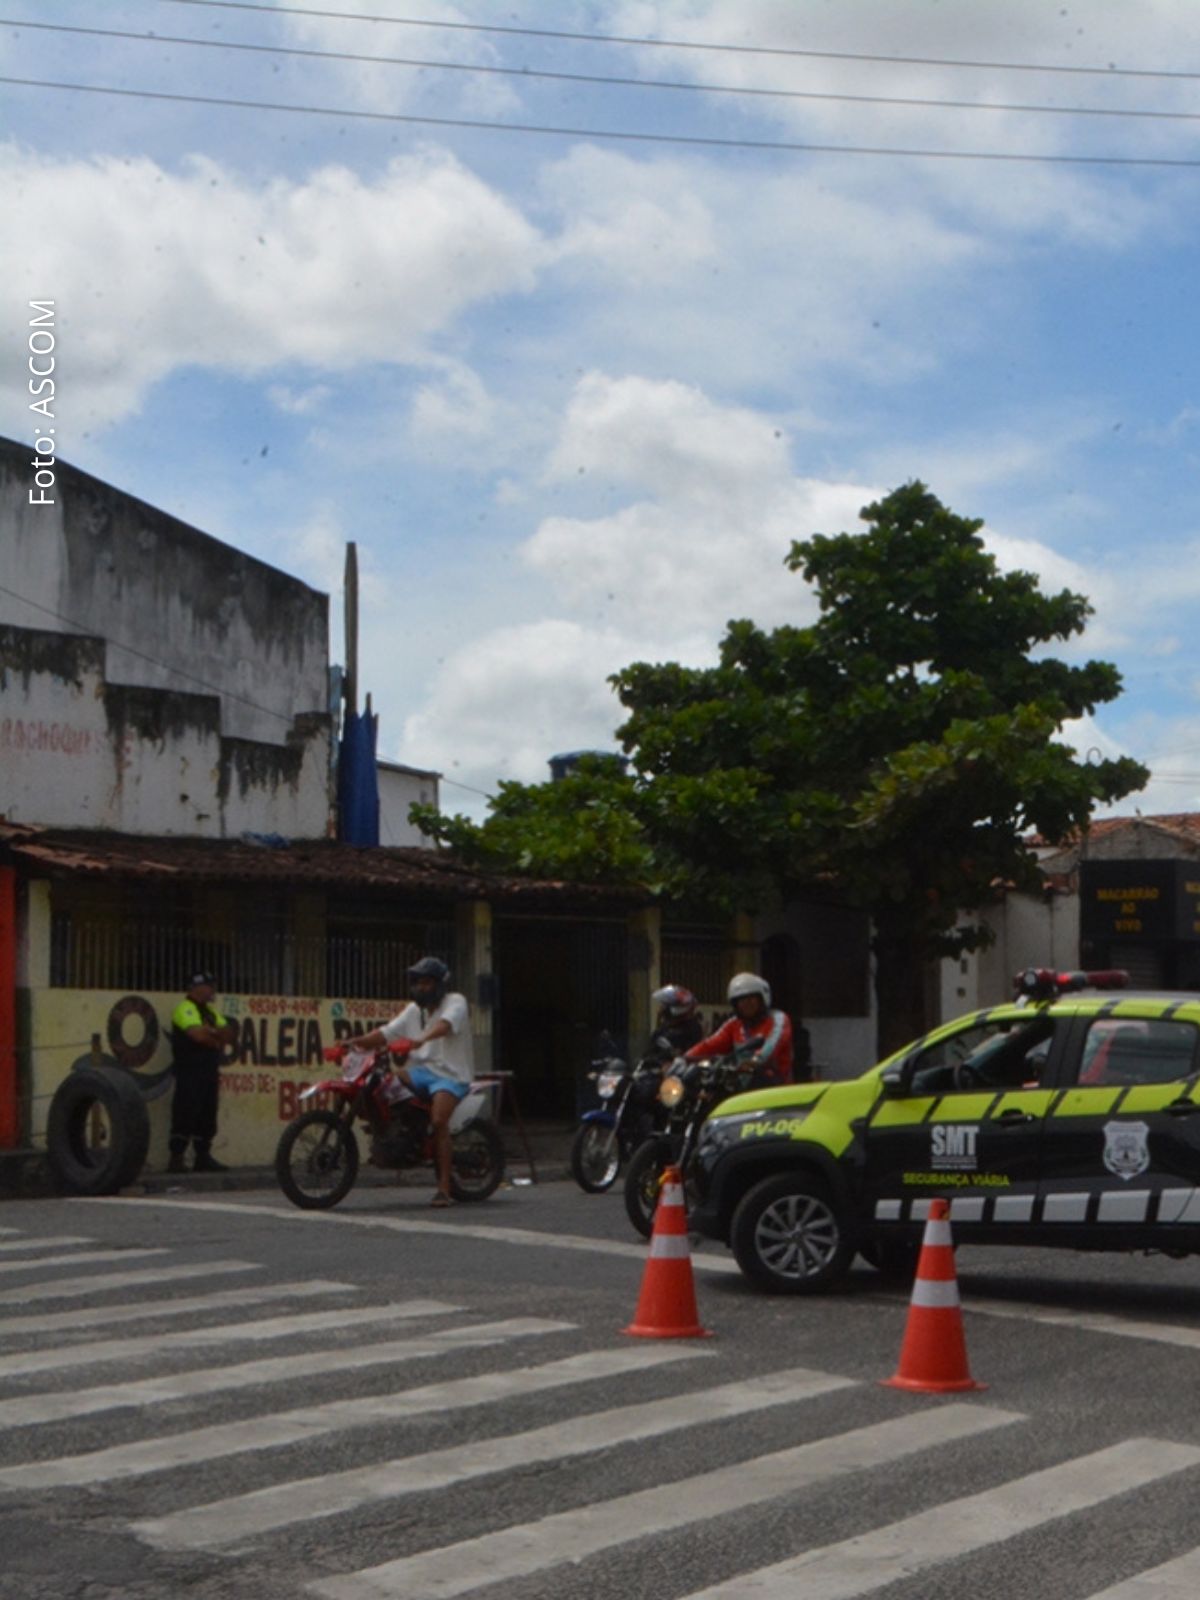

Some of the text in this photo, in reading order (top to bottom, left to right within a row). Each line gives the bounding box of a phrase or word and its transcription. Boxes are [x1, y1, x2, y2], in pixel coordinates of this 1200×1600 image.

[741, 1119, 802, 1139] PV-06
[931, 1125, 979, 1156] SMT
[903, 1172, 1010, 1188] SEGURANÇA VIÁRIA
